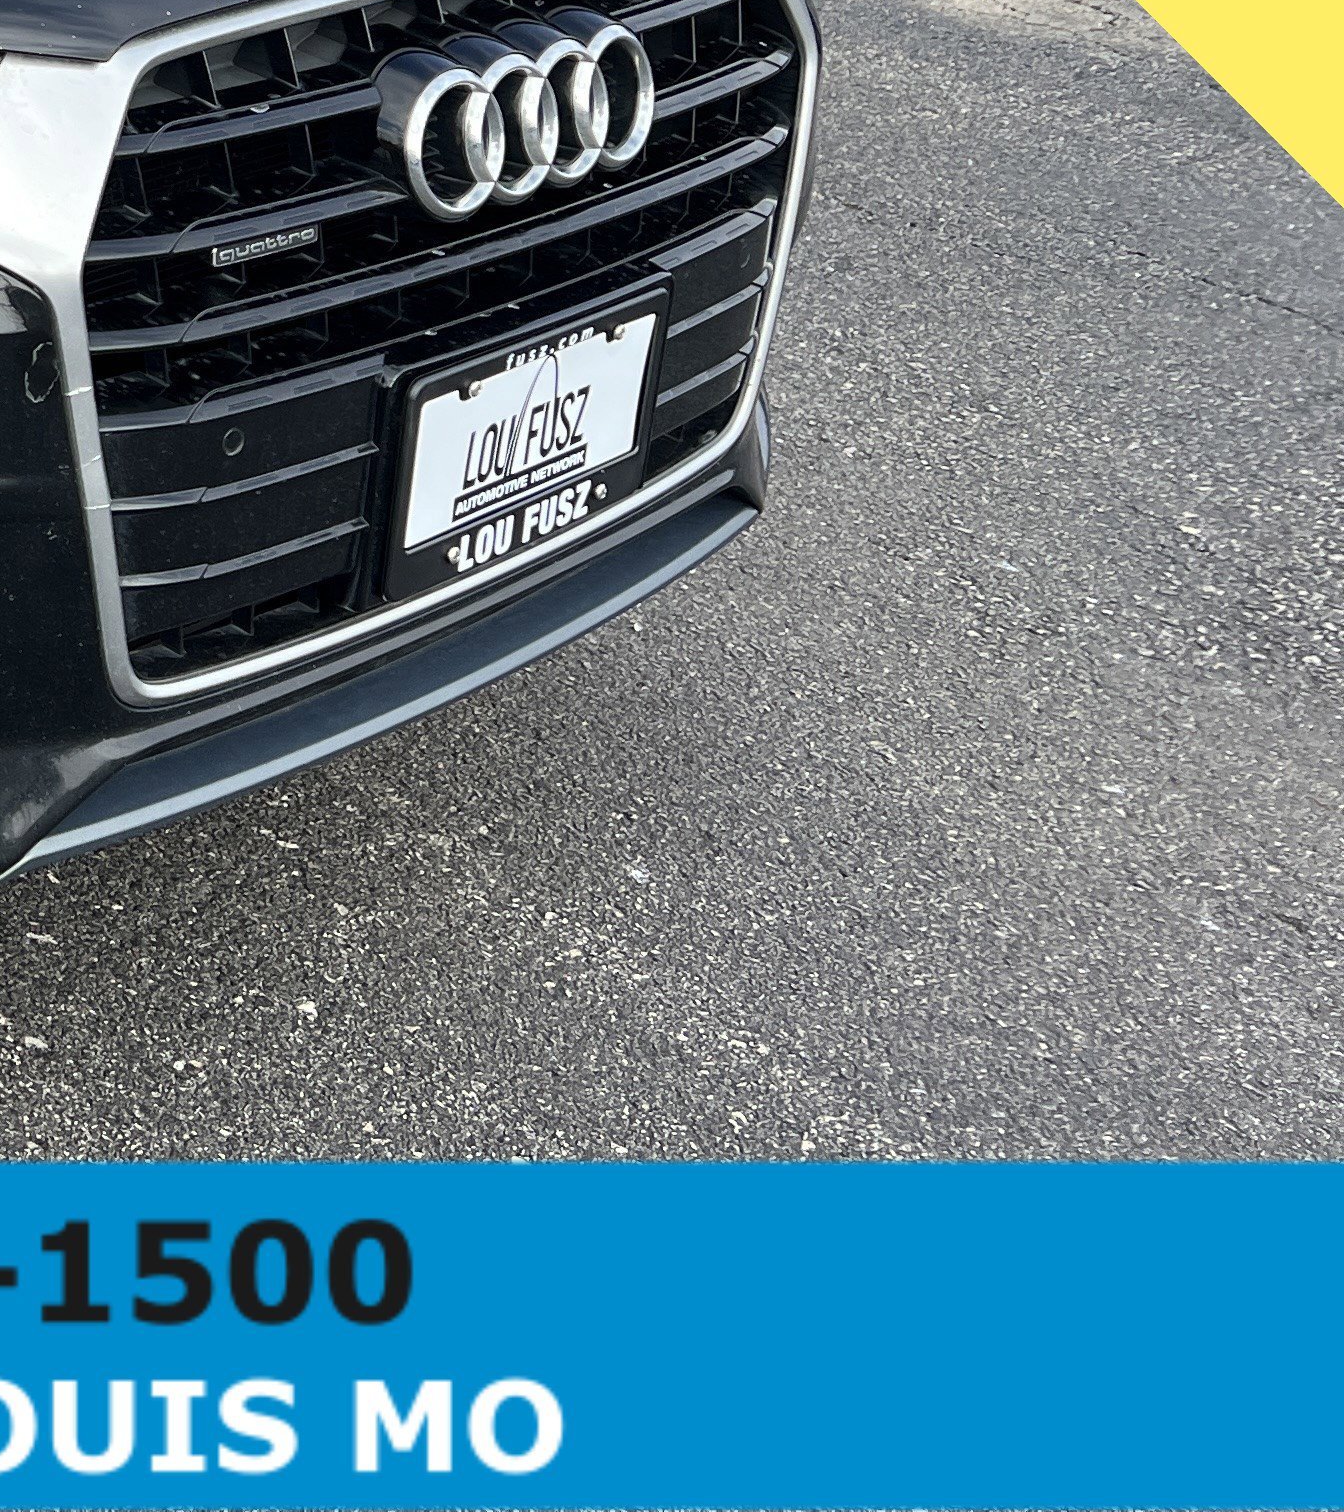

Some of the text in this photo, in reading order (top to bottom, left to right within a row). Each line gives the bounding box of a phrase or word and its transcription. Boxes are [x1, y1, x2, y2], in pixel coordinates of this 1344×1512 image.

[218, 227, 316, 263] quattro
[505, 326, 595, 371] fusz.com
[462, 384, 592, 491] LOU FUSZ
[454, 448, 587, 517] AUTOMOTIVE NETWORK
[457, 479, 592, 573] LOU FUSZ
